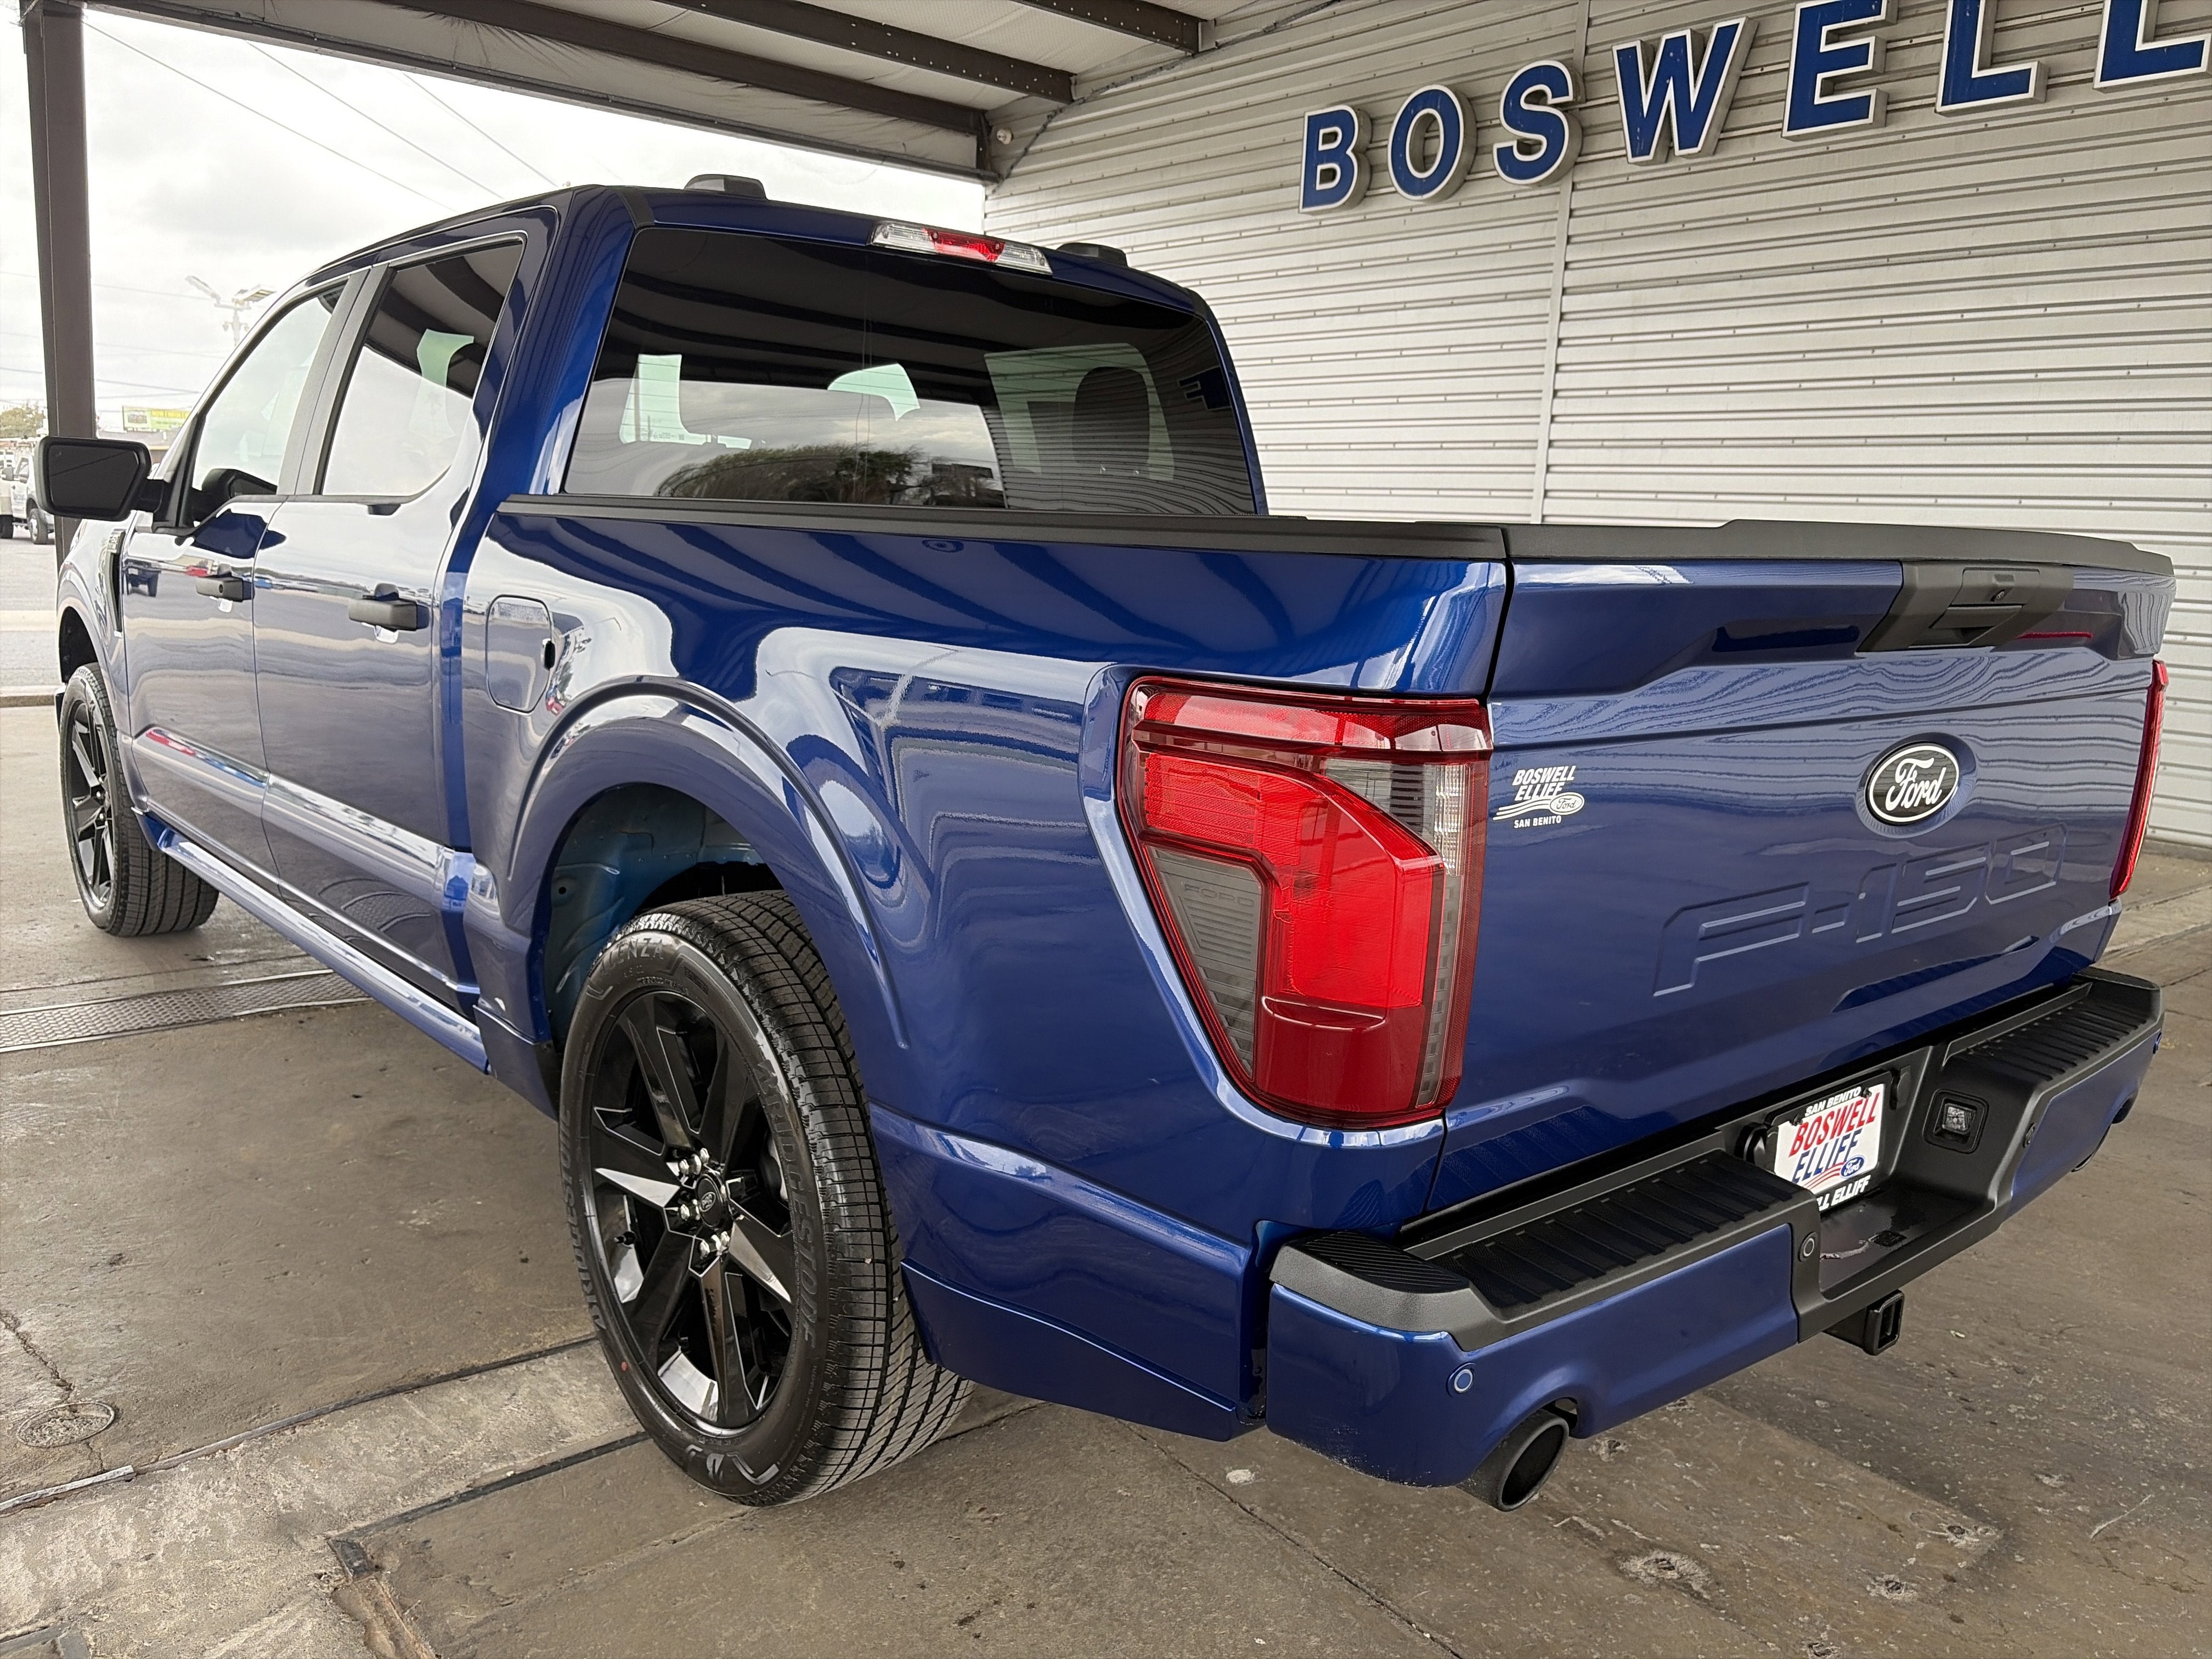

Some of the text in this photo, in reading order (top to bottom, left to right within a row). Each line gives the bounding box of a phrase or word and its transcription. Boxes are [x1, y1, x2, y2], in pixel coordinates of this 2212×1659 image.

[1299, 0, 2212, 214] BOSWELL
[1513, 765, 1576, 786] BOSWELL
[1886, 758, 1946, 811] Ford
[1515, 782, 1565, 801] ELLIFF
[1556, 798, 1576, 810] Ford
[1514, 816, 1562, 828] SAN BENITO
[1184, 884, 1255, 907] FORD
[1653, 822, 2067, 997] F-150
[1804, 1086, 1861, 1117] SAN BENITO
[1788, 1092, 1881, 1158] BOSWELL
[1792, 1128, 1863, 1183] ELLIFF
[1843, 1158, 1863, 1176] Ford
[1831, 1175, 1871, 1204] ELLIFF
